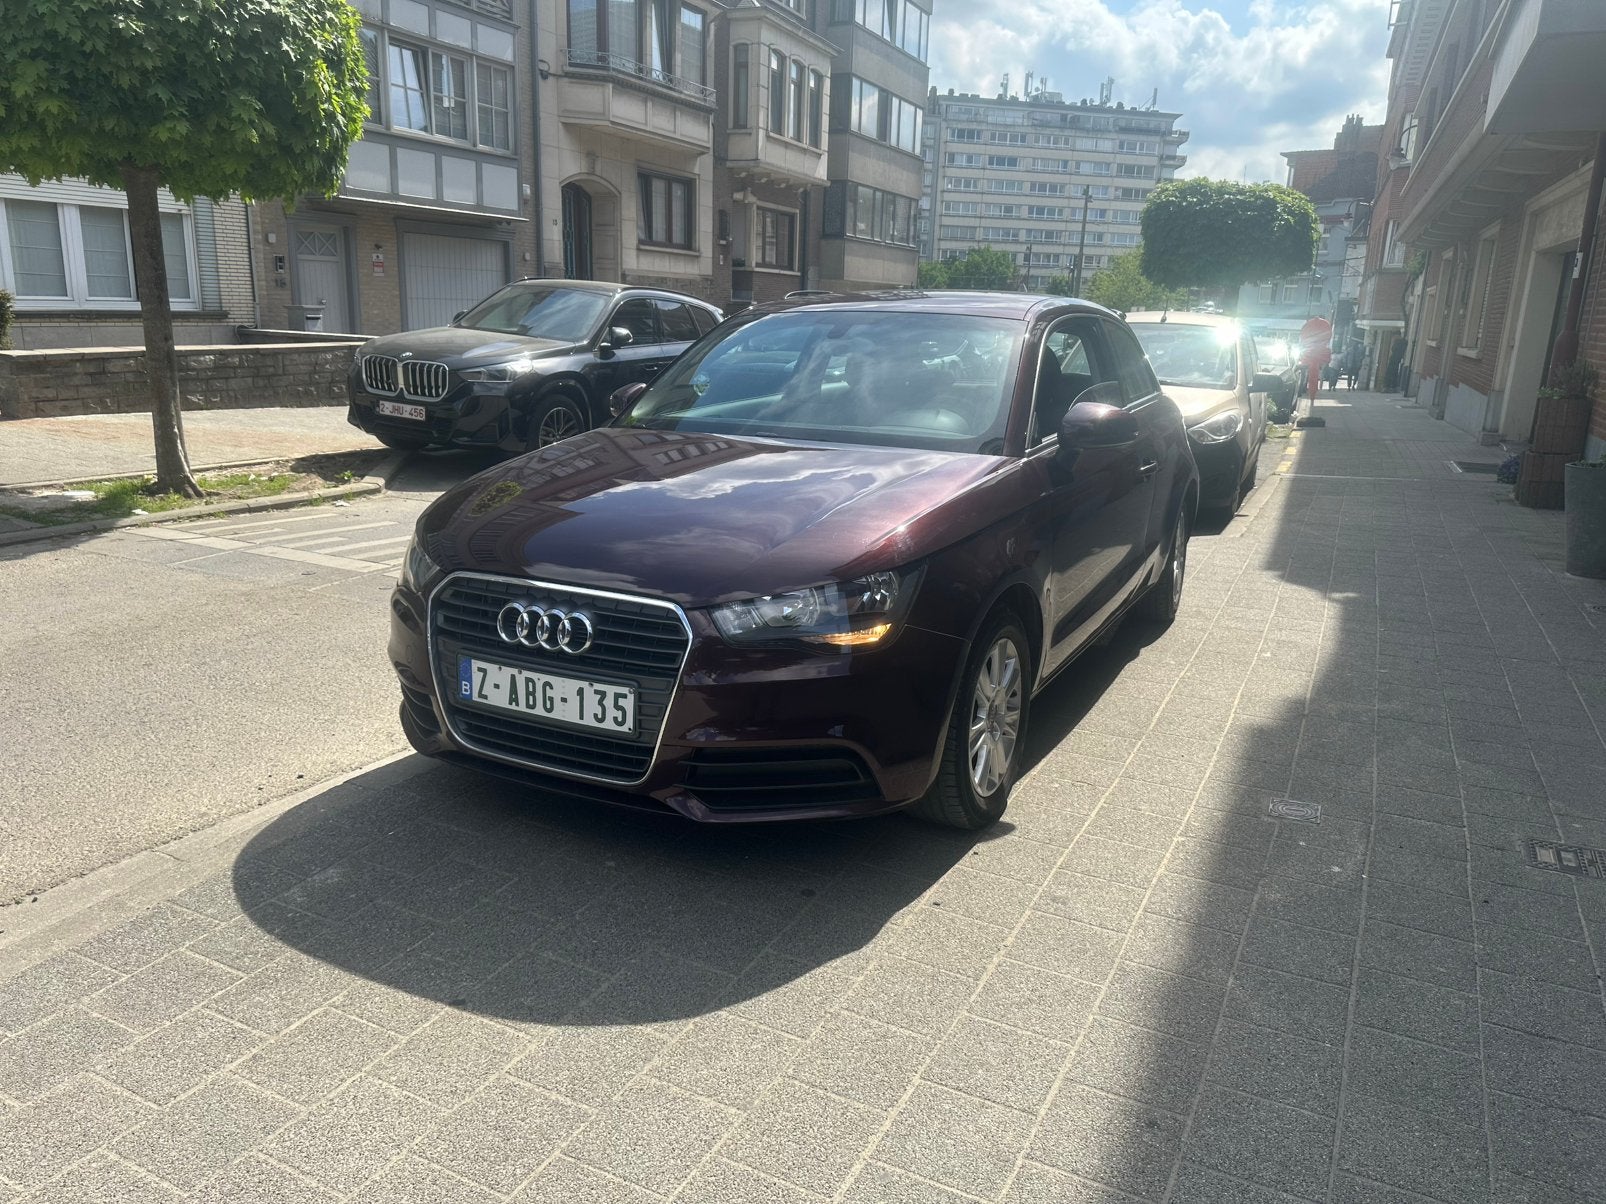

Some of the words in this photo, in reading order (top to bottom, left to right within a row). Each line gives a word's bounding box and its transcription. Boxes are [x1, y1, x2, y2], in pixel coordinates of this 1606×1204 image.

[380, 402, 424, 419] 2-JHU-456
[461, 680, 471, 695] B
[476, 666, 628, 727] Z-ABG-135
